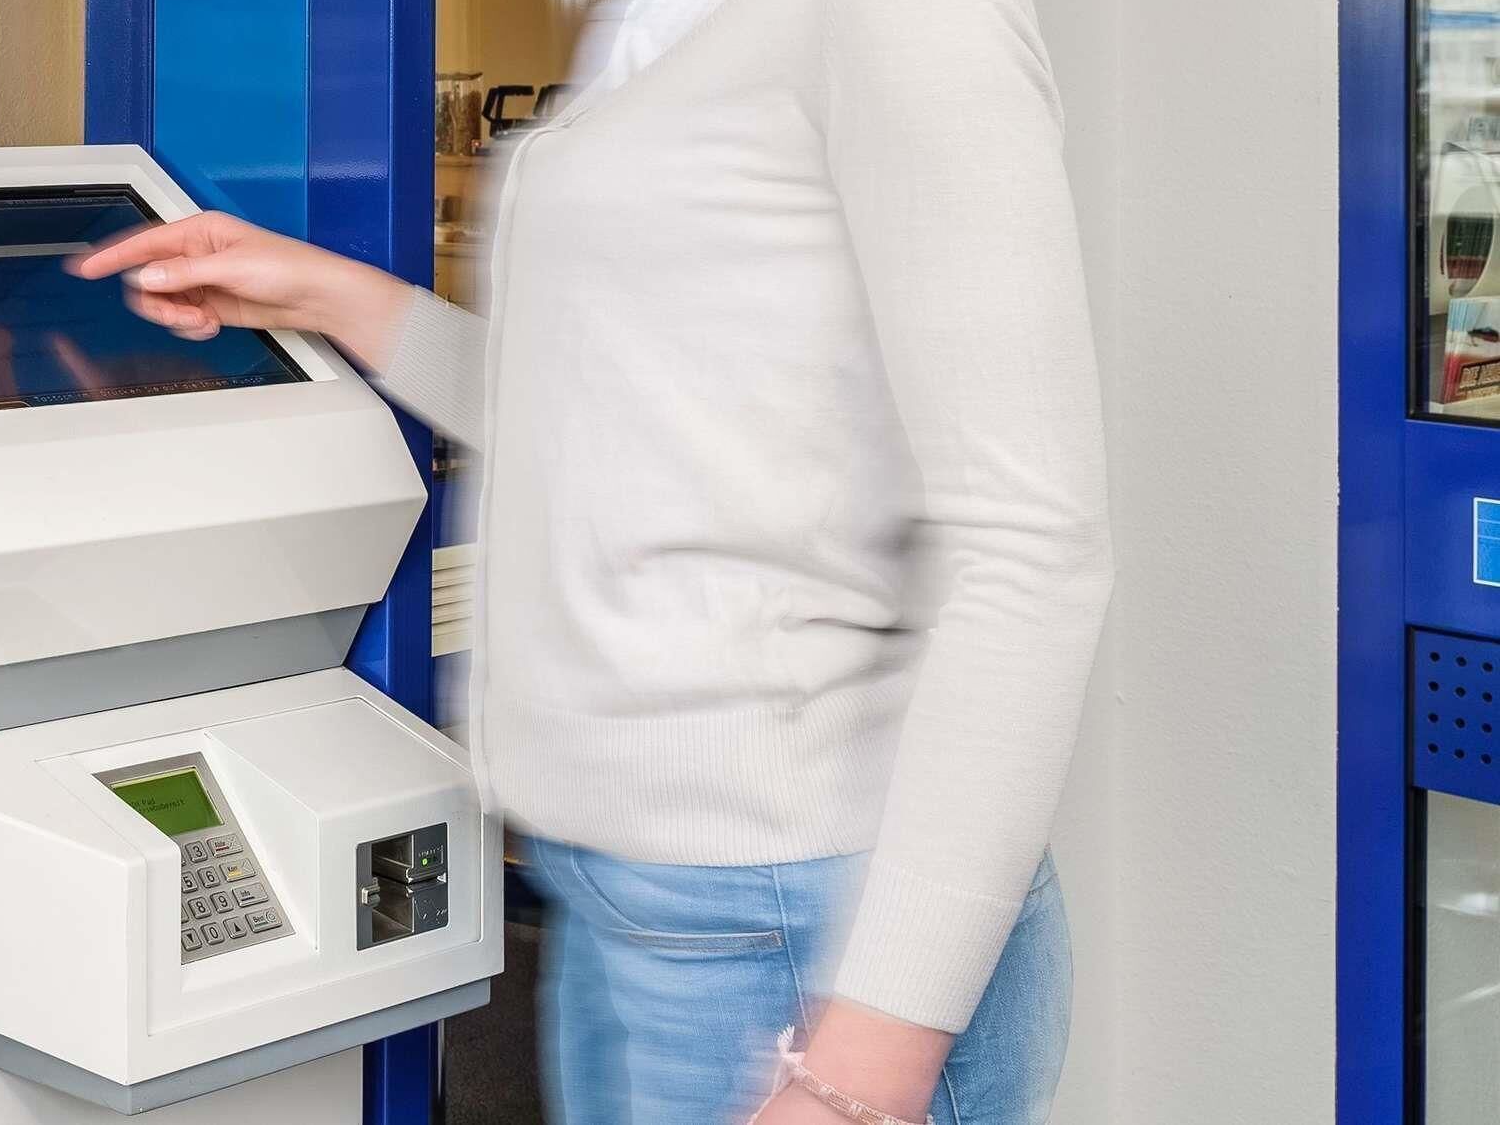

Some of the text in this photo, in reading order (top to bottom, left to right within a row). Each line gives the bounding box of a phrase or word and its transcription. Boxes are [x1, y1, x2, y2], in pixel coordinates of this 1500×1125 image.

[193, 846, 202, 857] 3
[183, 871, 215, 888] 5 6
[197, 895, 228, 913] 8 9
